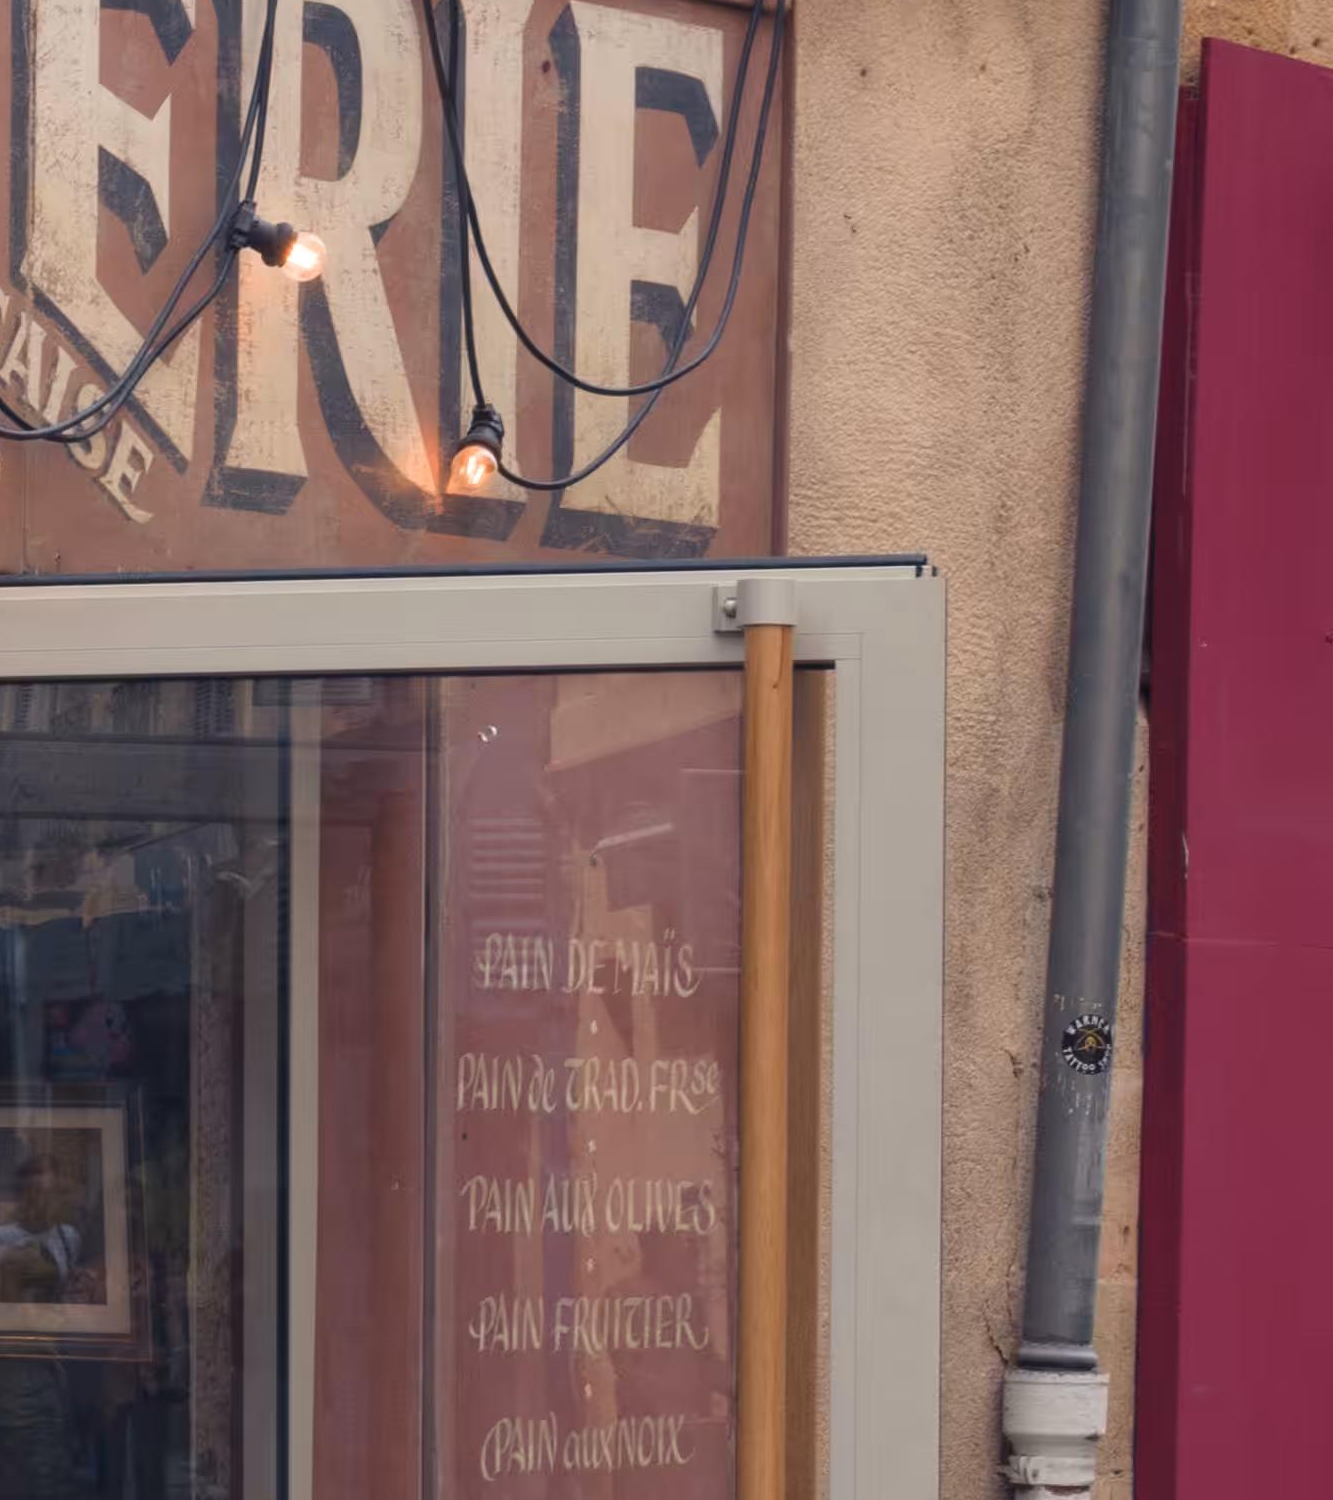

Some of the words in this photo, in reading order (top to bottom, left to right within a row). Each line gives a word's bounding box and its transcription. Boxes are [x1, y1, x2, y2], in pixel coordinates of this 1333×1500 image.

[477, 931, 554, 991] PAIN
[561, 938, 606, 994] DE
[612, 927, 704, 999] MAÏS
[456, 1052, 524, 1116] PAIN
[461, 1174, 533, 1237] PAIN
[540, 1171, 598, 1238] AUX
[604, 1177, 724, 1236] OLIVES
[468, 1291, 544, 1354] PAIN
[553, 1291, 710, 1356] FRUITIER
[480, 1411, 558, 1482] PAIN
[616, 1413, 697, 1471] NOIX
